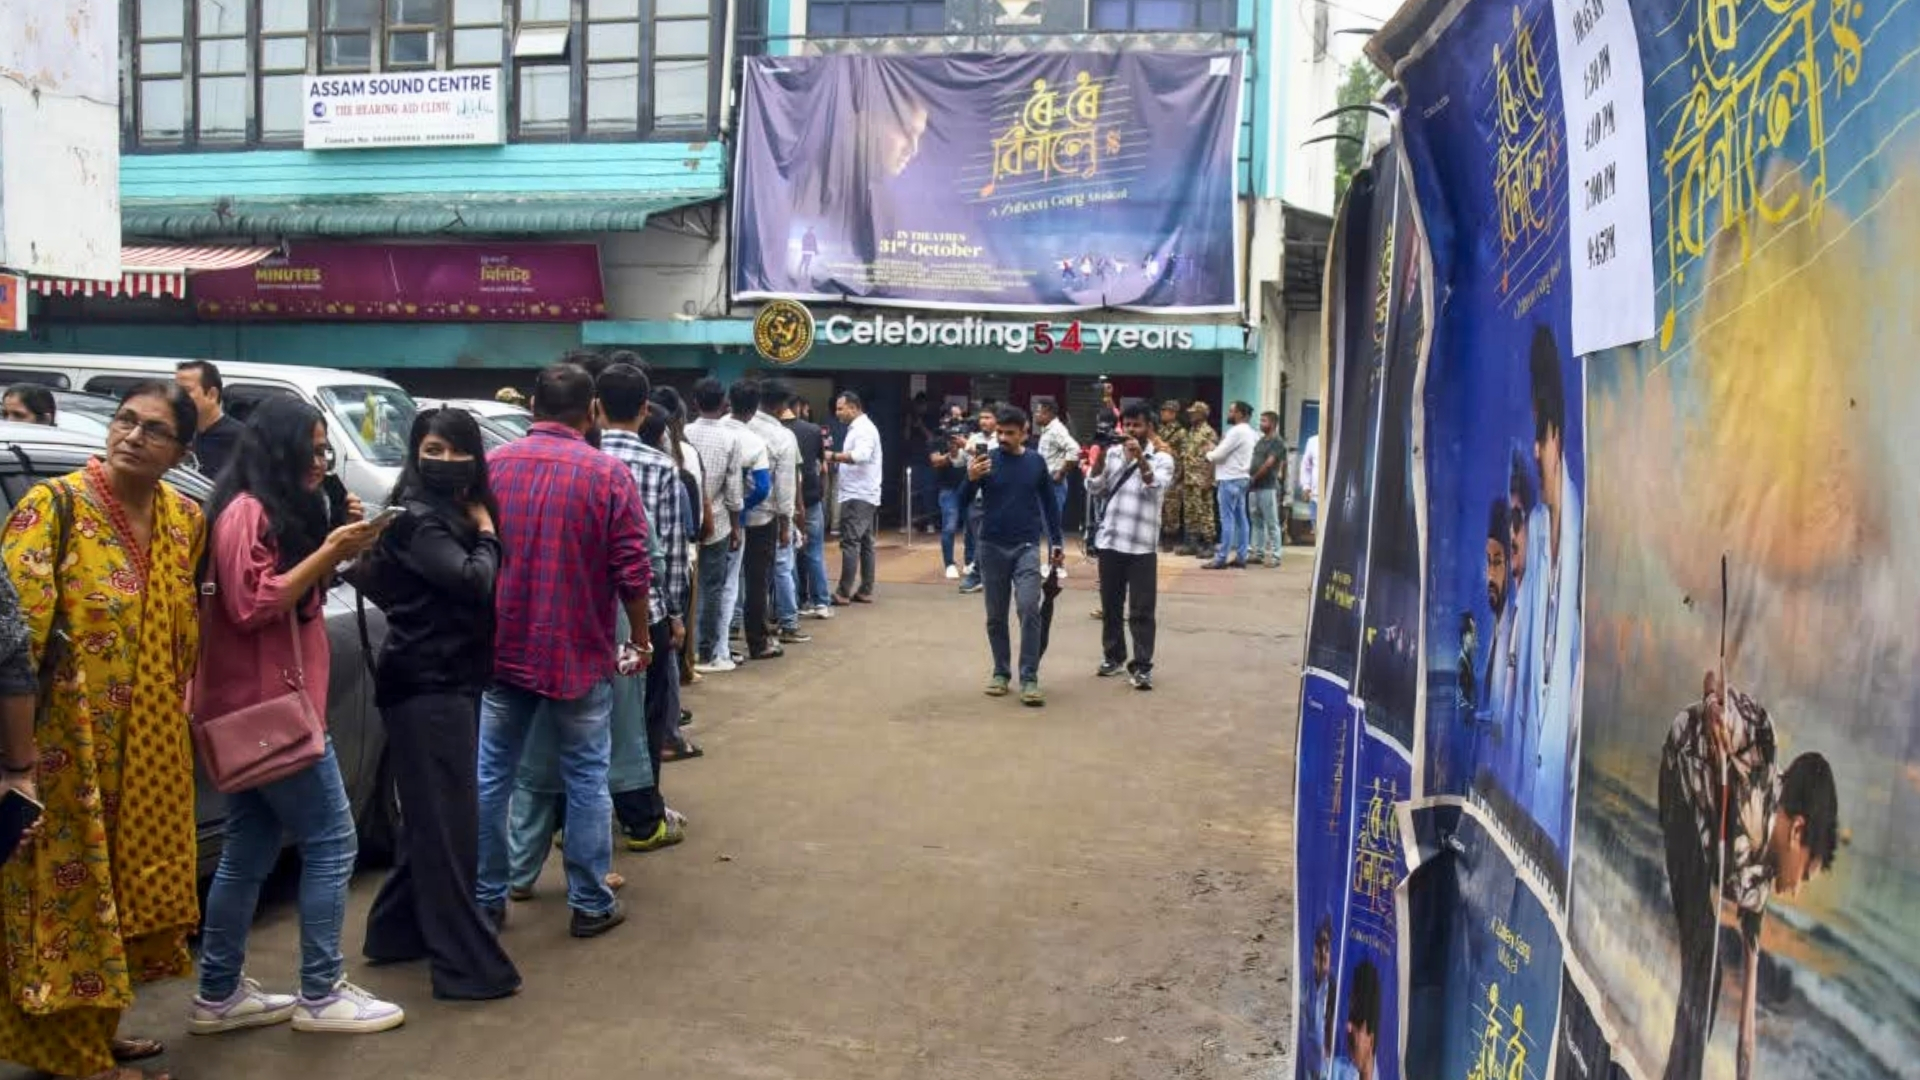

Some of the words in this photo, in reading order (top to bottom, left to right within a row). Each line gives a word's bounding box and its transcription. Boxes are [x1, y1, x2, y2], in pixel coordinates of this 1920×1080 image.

[1599, 43, 1611, 85] PM
[310, 80, 365, 97] ASSAM
[369, 78, 424, 95] SOUND
[428, 75, 492, 92] CENTRE
[335, 104, 353, 116] THE
[355, 102, 398, 116] HEARING
[401, 102, 419, 114] AID
[421, 100, 451, 113] CLINIC
[1602, 99, 1615, 141] PM
[1604, 161, 1616, 200] PM
[911, 242, 983, 257] October
[824, 314, 1028, 353] Celebrating
[1096, 325, 1193, 354] years
